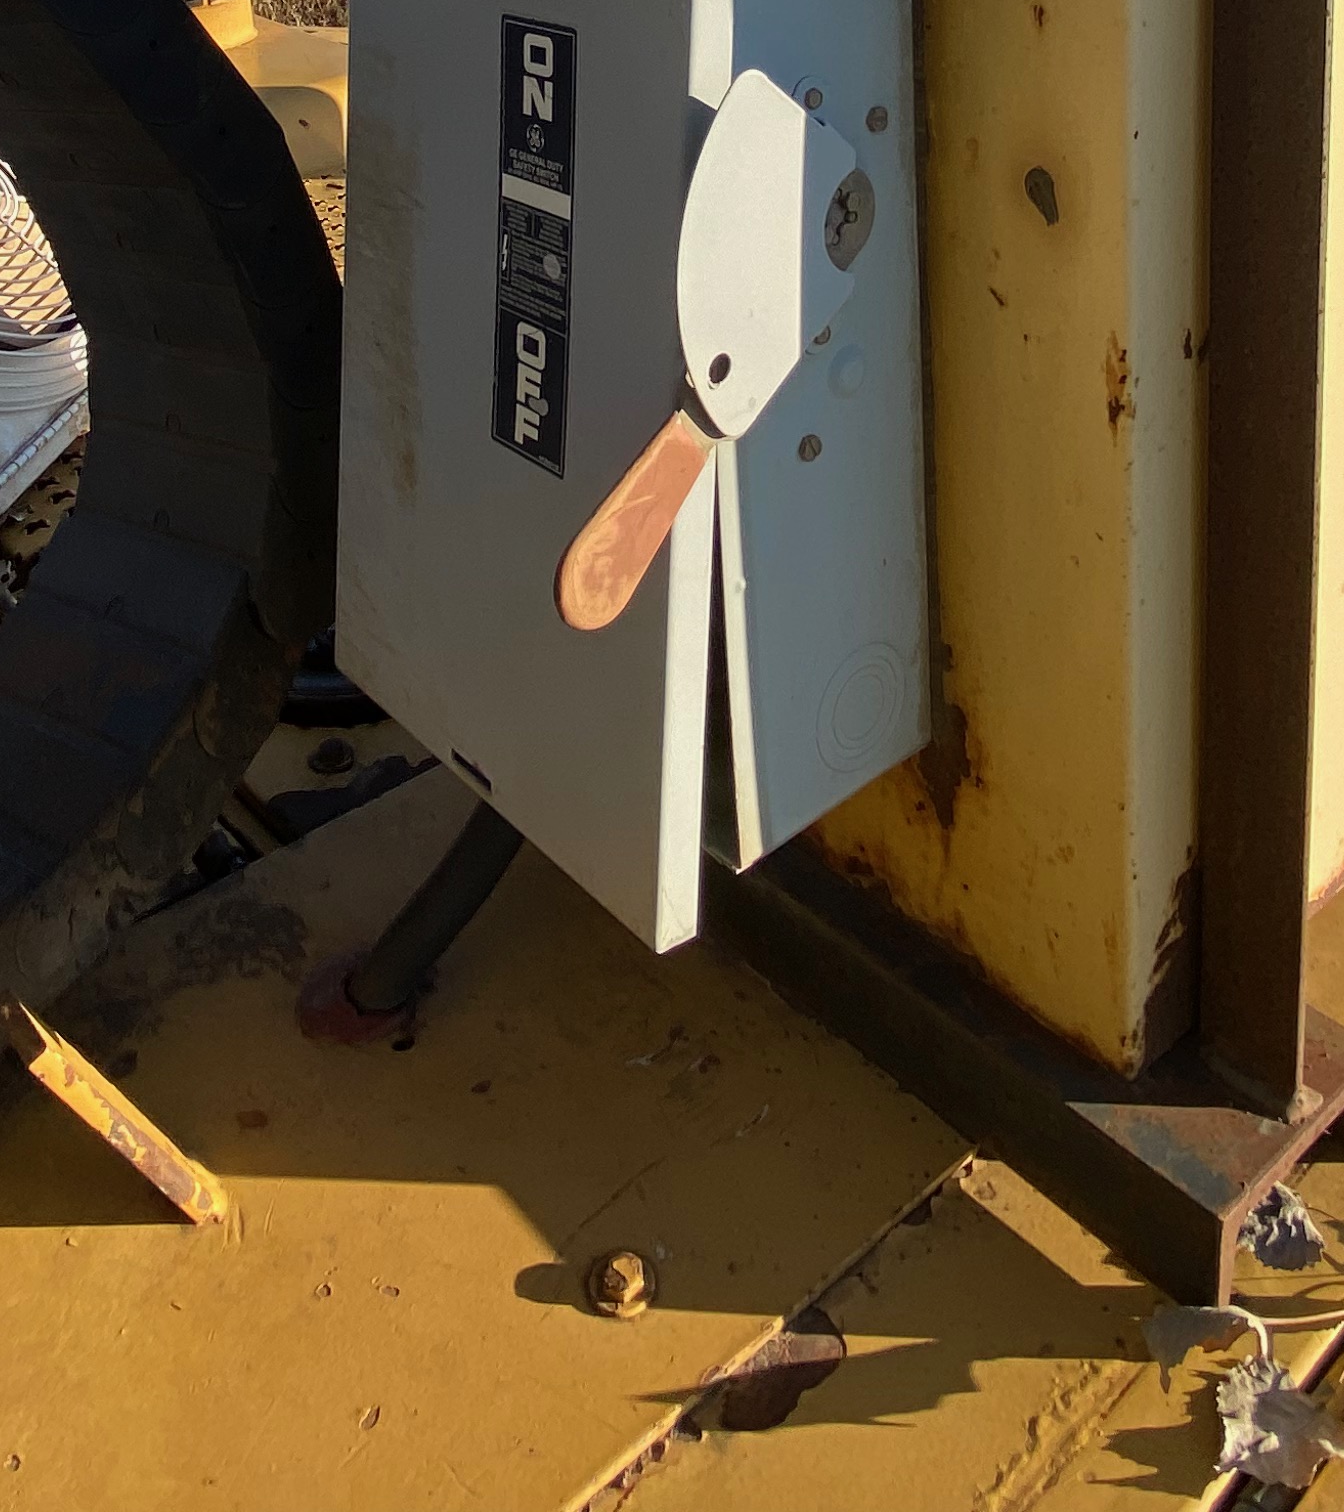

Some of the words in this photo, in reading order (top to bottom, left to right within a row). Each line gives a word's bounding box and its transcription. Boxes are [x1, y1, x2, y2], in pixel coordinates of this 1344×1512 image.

[523, 33, 553, 122] ON
[518, 150, 546, 168] GENERAL
[514, 321, 546, 445] OFF
